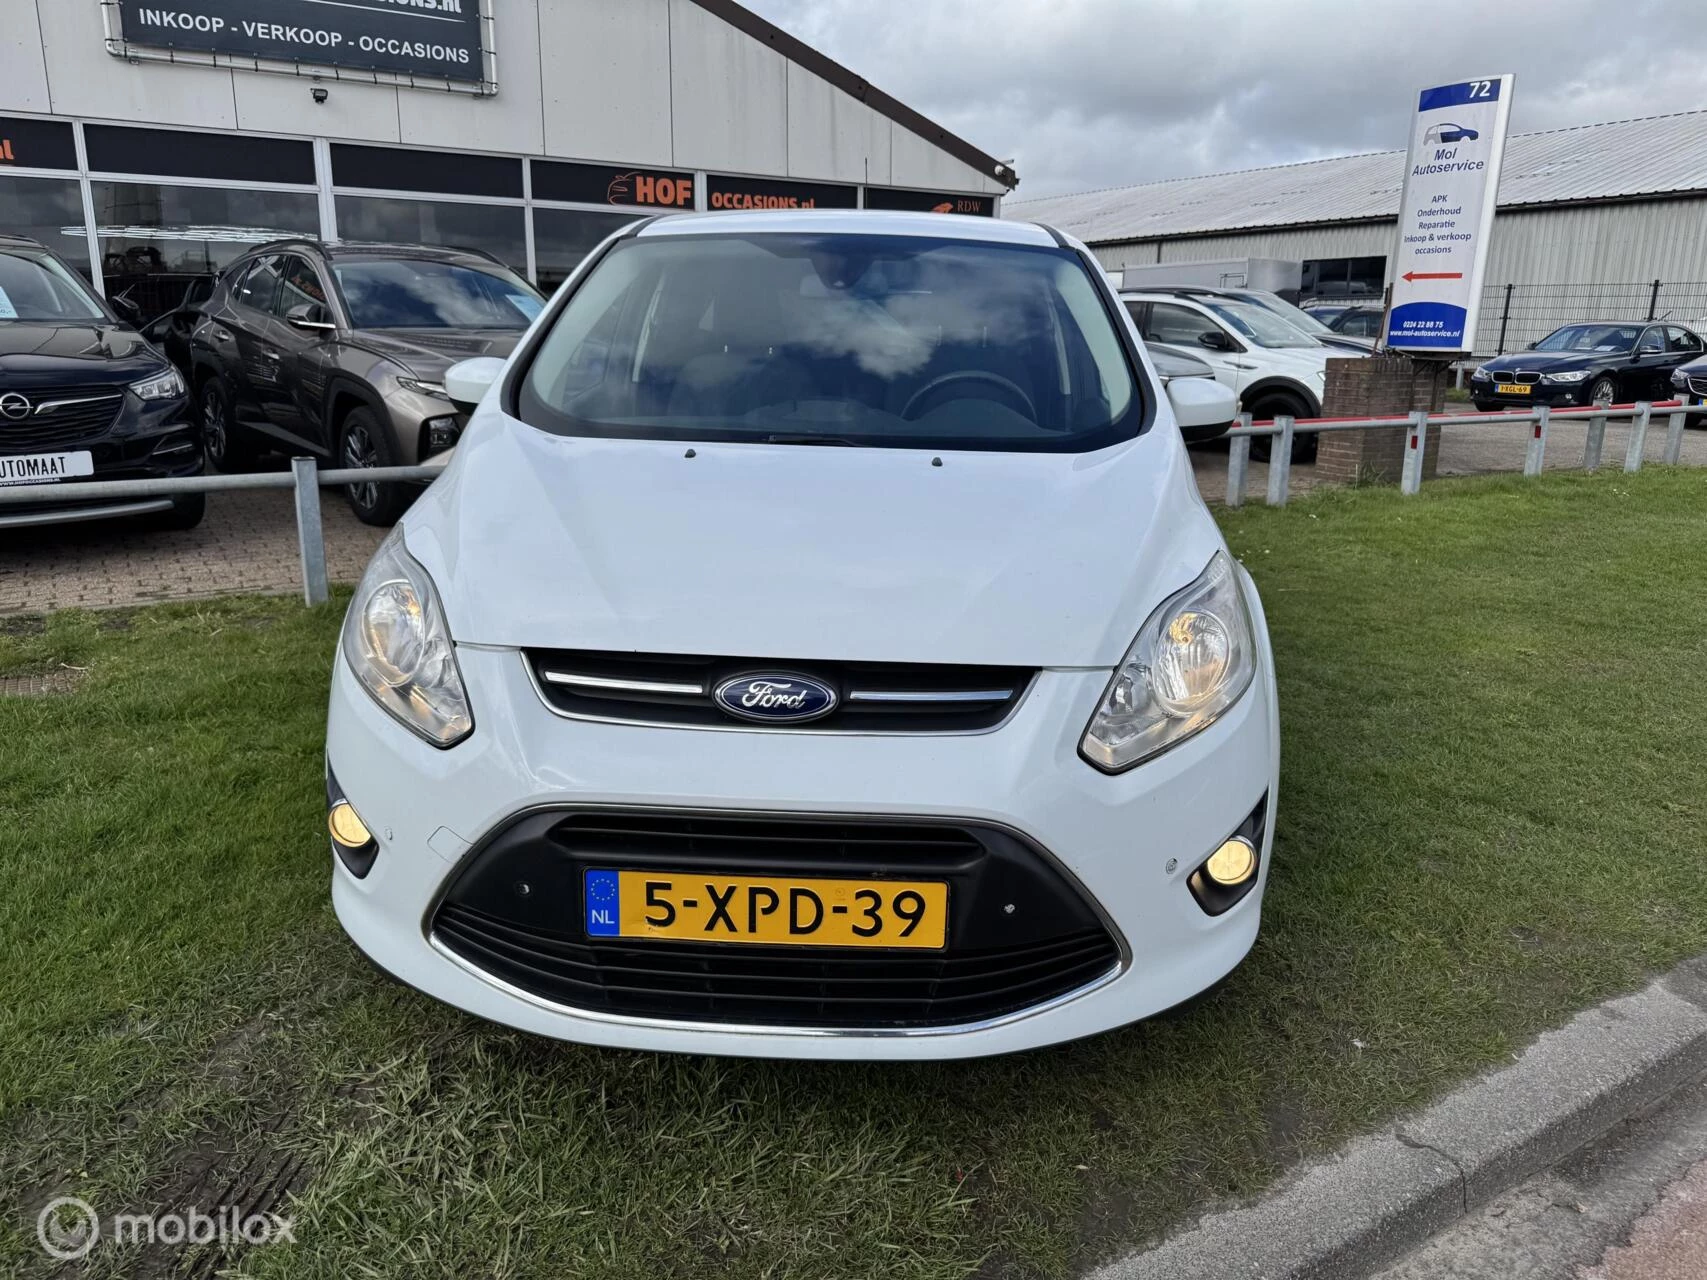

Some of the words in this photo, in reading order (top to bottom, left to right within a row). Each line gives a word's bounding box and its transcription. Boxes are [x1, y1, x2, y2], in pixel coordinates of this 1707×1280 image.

[139, 8, 224, 33] INKOOP
[242, 21, 342, 47] VERKOOP
[359, 36, 470, 63] OCCASIONS
[1469, 81, 1491, 98] 72
[1434, 147, 1457, 161] Mol
[1412, 159, 1484, 176] Autoservice
[636, 175, 692, 206] HOF
[1431, 195, 1448, 203] APK
[957, 200, 981, 212] RDW
[1417, 206, 1462, 217] Onderhoud
[1418, 220, 1456, 231] Reparatie
[1404, 234, 1427, 243] Inkoop
[1428, 233, 1435, 241] &
[1437, 232, 1472, 242] verkoop
[1414, 246, 1452, 255] occasions
[1389, 329, 1460, 337] www.mol-autoservice.nl
[741, 681, 807, 709] Ford
[592, 910, 615, 925] NL
[644, 881, 926, 937] 5-XPD-39
